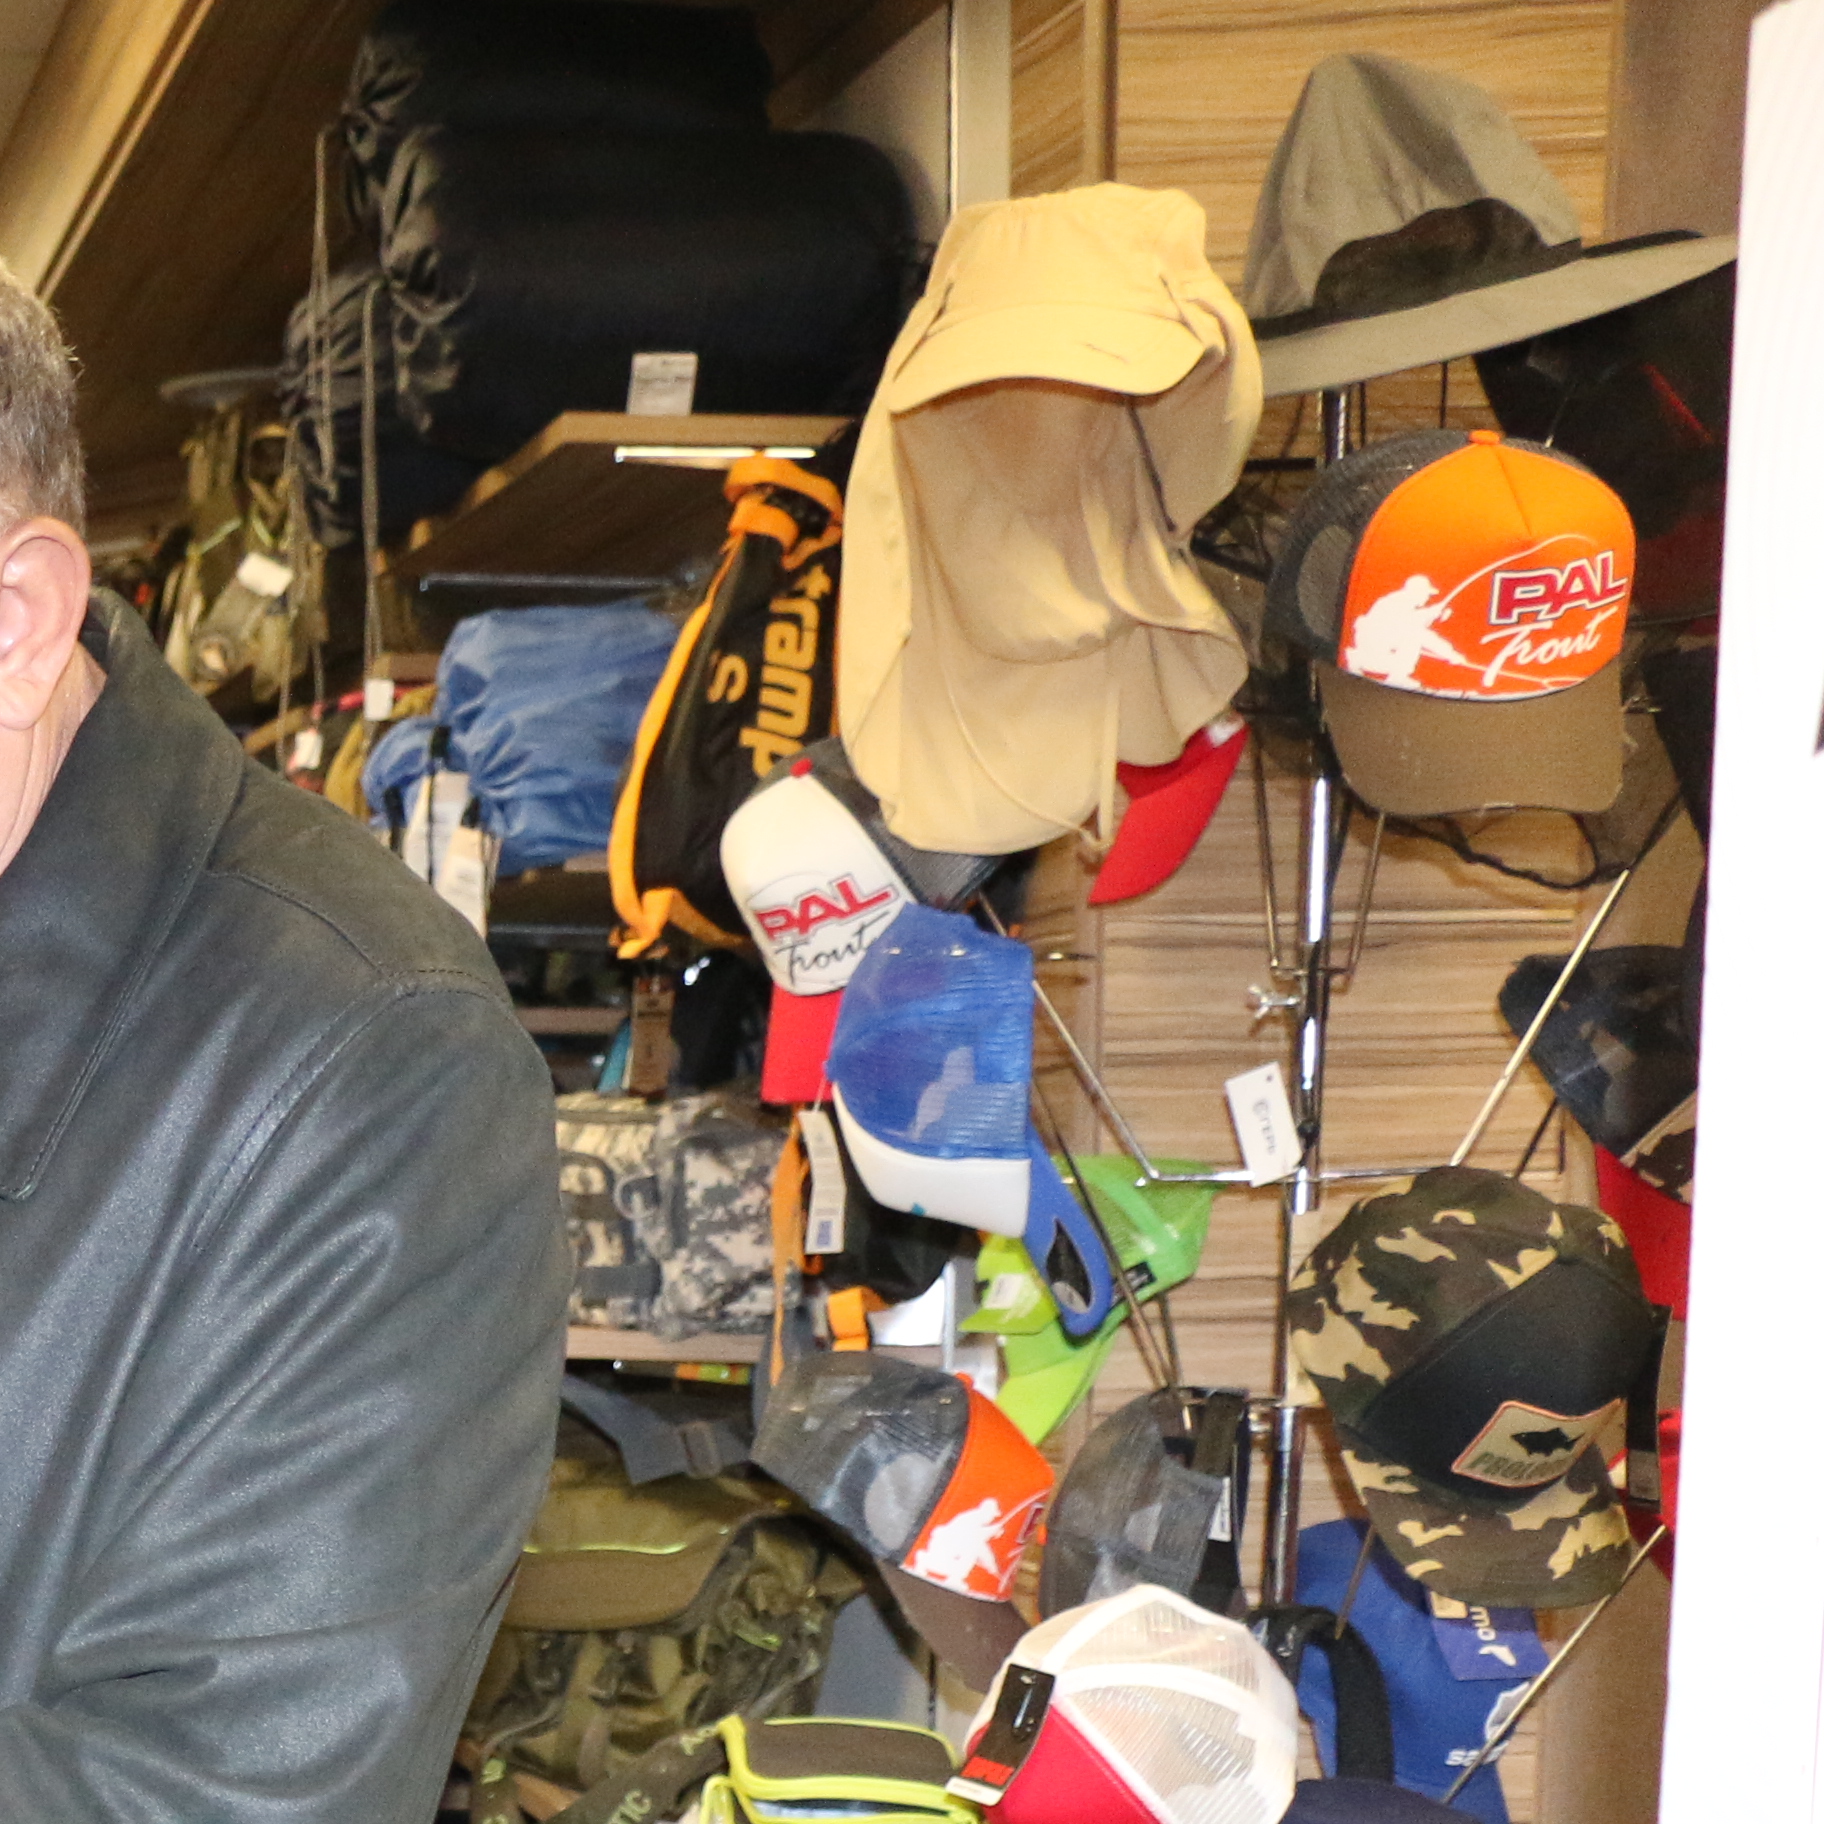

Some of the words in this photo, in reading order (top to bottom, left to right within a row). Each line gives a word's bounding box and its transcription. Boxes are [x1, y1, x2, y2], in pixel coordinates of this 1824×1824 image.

[1489, 549, 1628, 625] PAL
[1479, 606, 1618, 688] Trout
[752, 875, 897, 942] PAL
[774, 909, 890, 988] Trout
